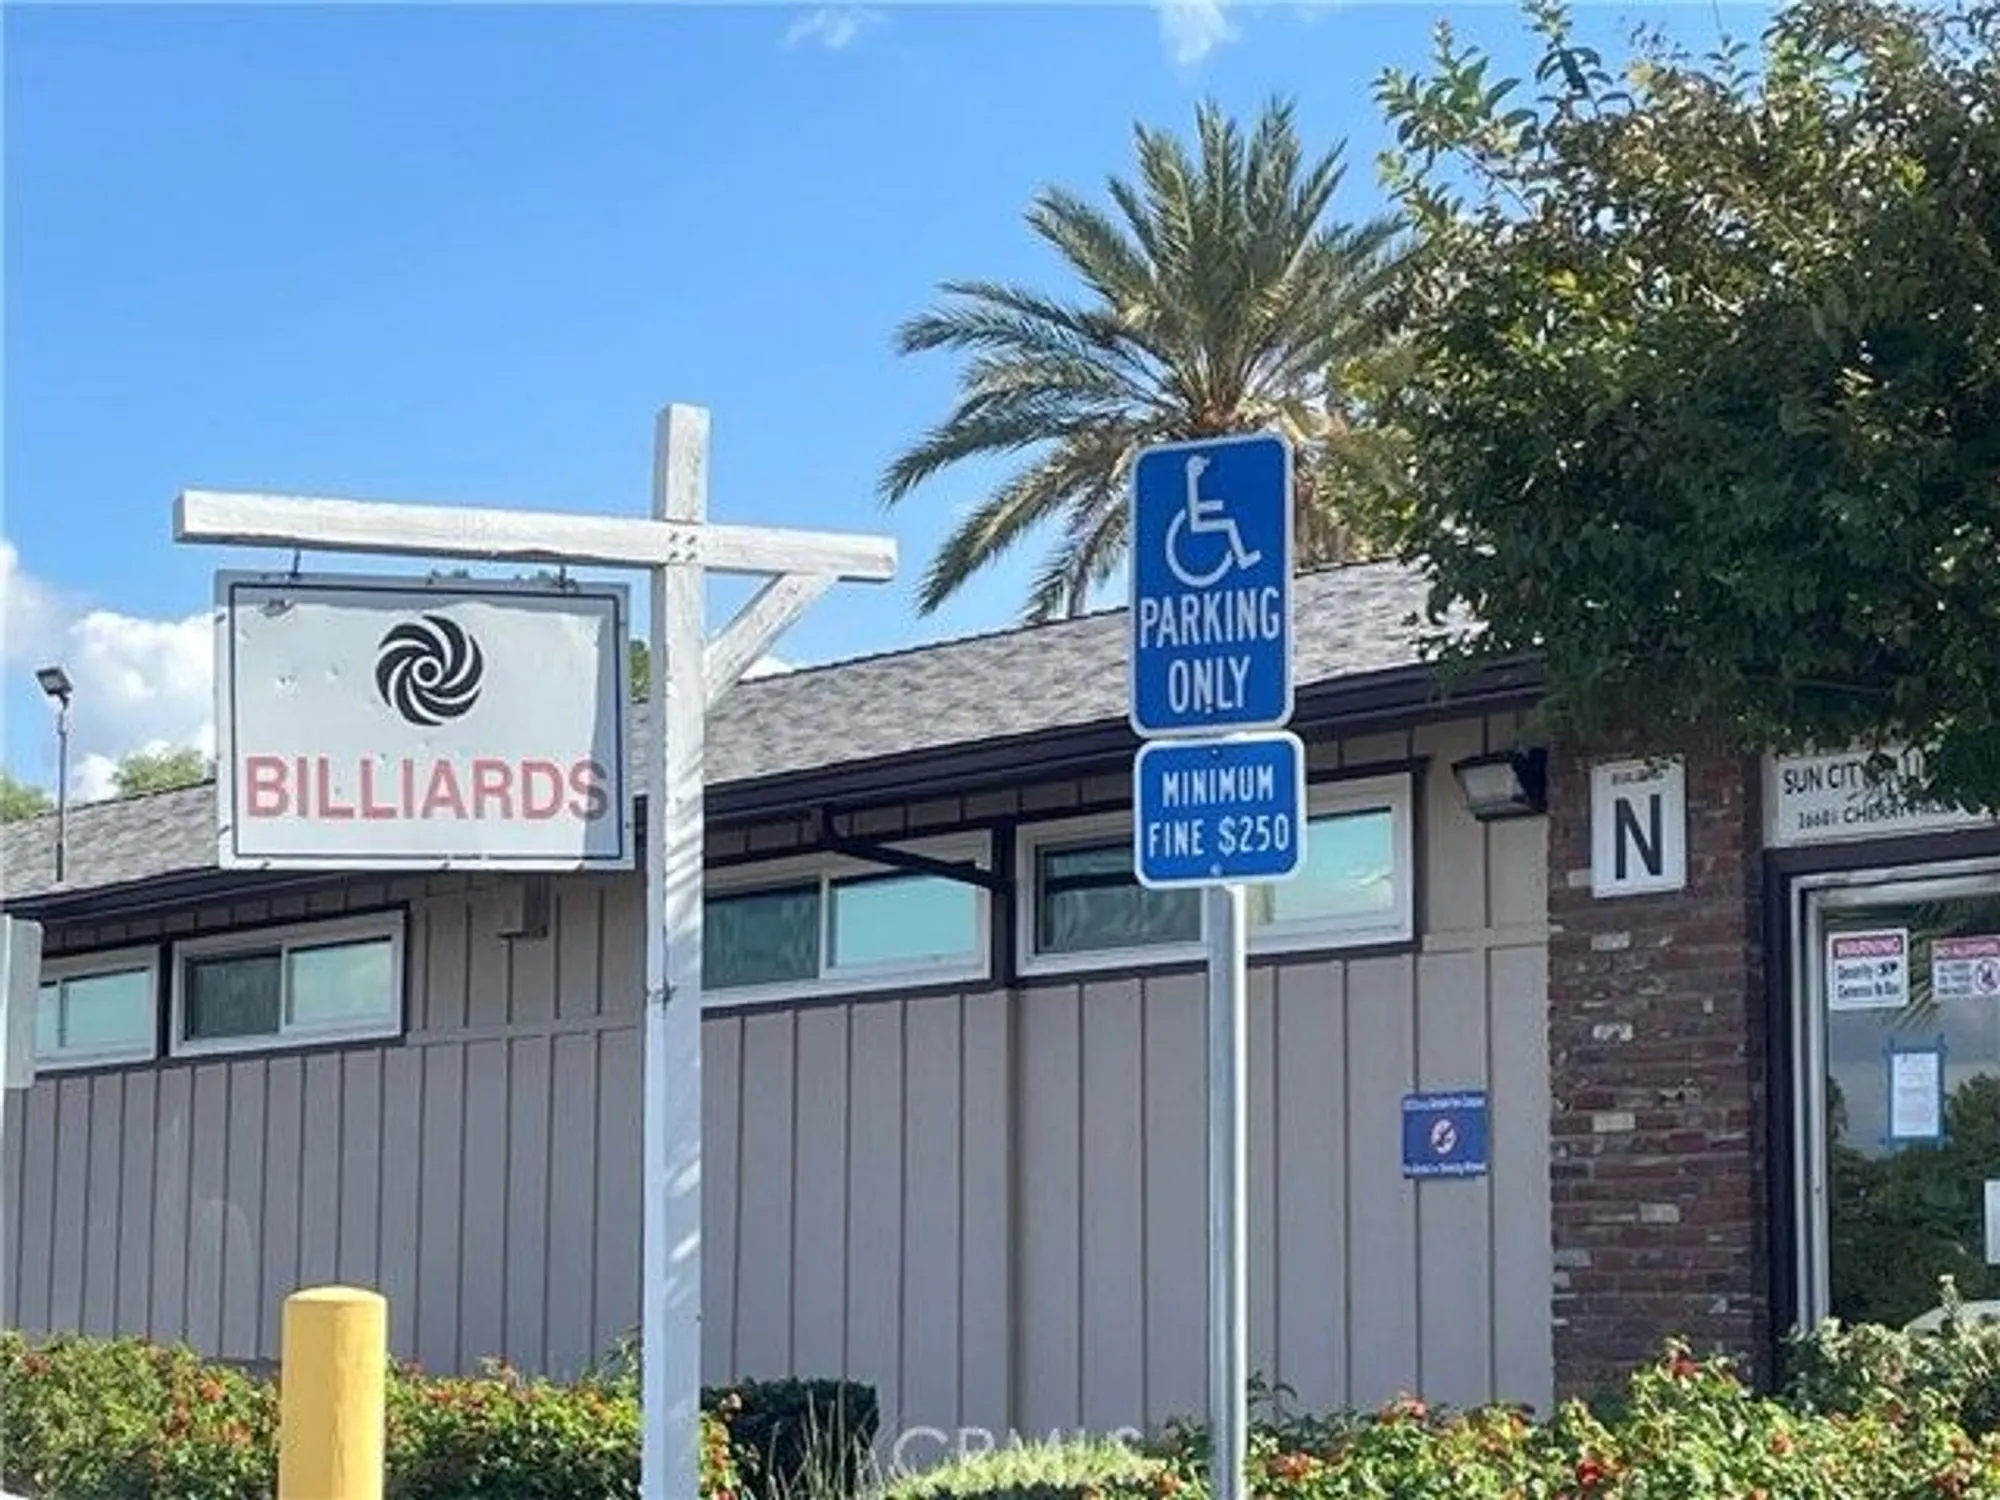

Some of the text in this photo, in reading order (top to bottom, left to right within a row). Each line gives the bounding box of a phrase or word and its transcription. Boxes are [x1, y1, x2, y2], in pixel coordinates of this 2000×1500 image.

[1139, 587, 1281, 649] PARKING
[1168, 655, 1251, 715] ONLY
[245, 755, 609, 821] BILLIARDS
[1161, 764, 1275, 808] MINIMUM
[1783, 763, 1823, 794] SUN
[1148, 811, 1290, 859] FINE $250
[1615, 793, 1663, 881] N
